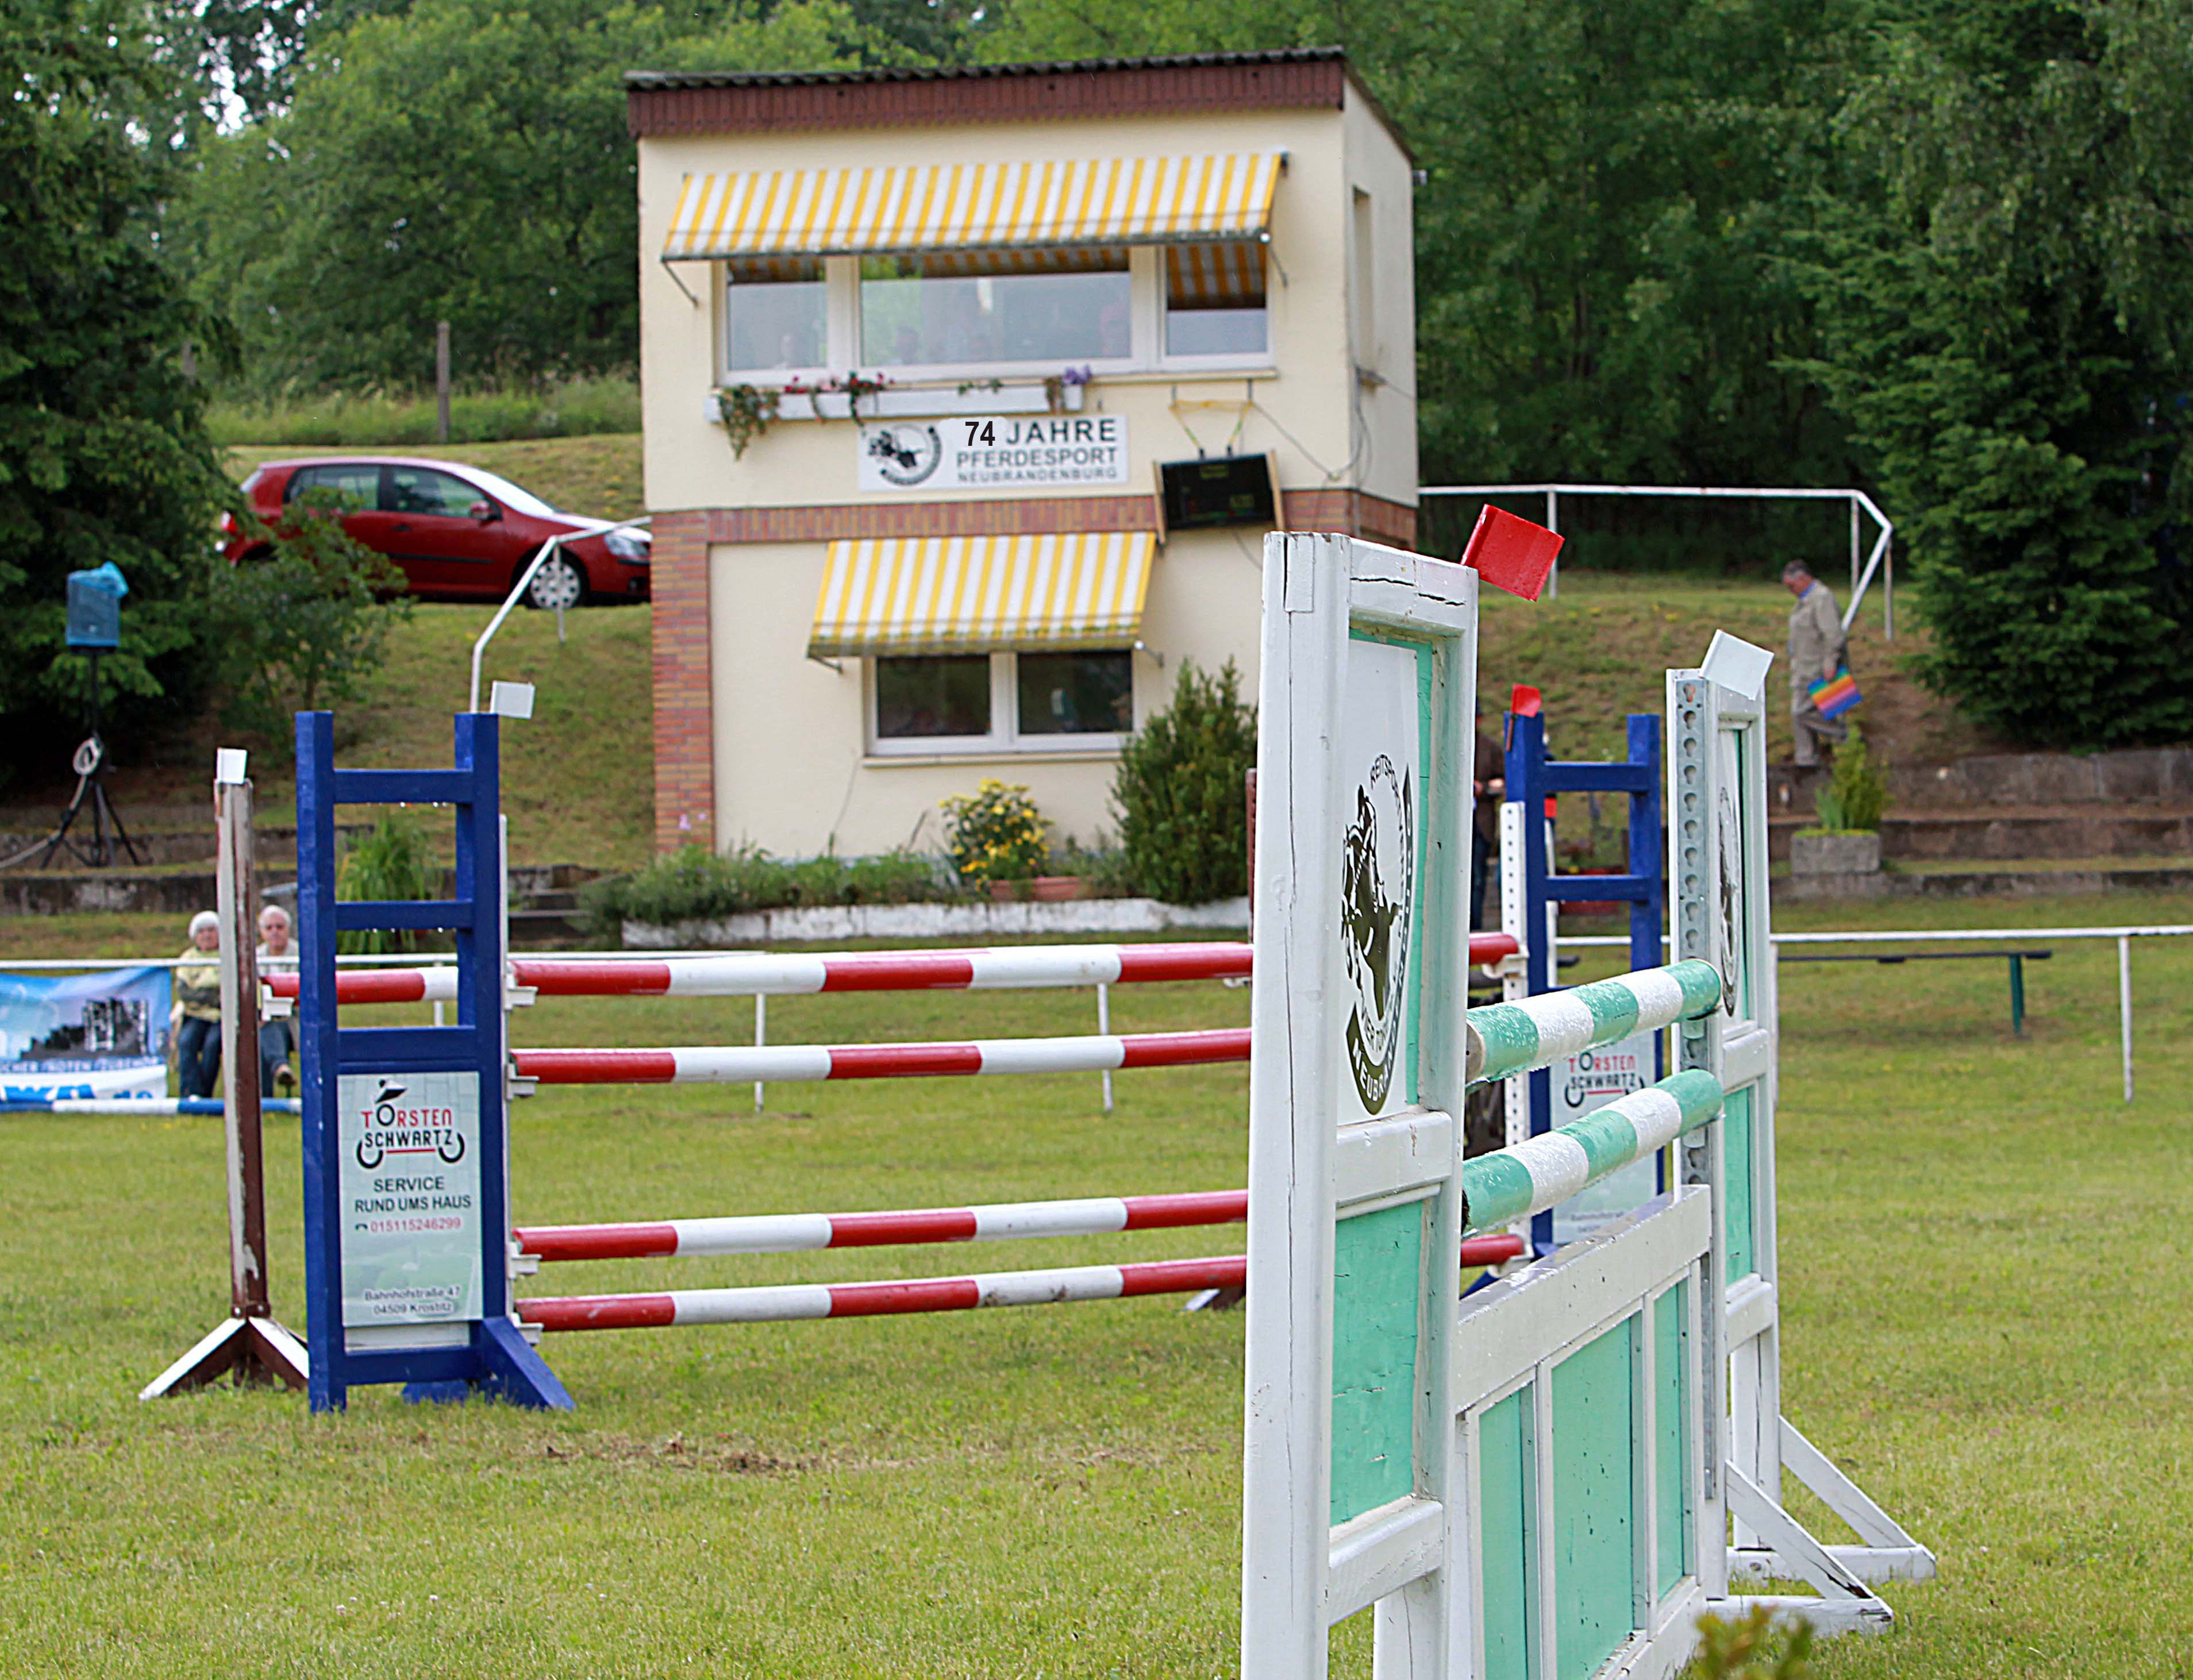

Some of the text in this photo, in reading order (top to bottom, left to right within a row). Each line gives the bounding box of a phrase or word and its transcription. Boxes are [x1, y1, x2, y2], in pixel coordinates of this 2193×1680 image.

[965, 419, 1116, 446] 74 JAHRE
[957, 446, 1117, 468] PFERDESPORT
[958, 467, 1117, 484] NEUBRANDENBURG
[1569, 1052, 1636, 1073] TORSTEN
[1571, 1073, 1636, 1089] SCHWARTZ
[361, 1104, 452, 1128] TORSTEN
[364, 1129, 452, 1148] SCHWARTZ
[374, 1176, 445, 1193] SERVICE
[355, 1195, 471, 1213] RUND UMS HAUS
